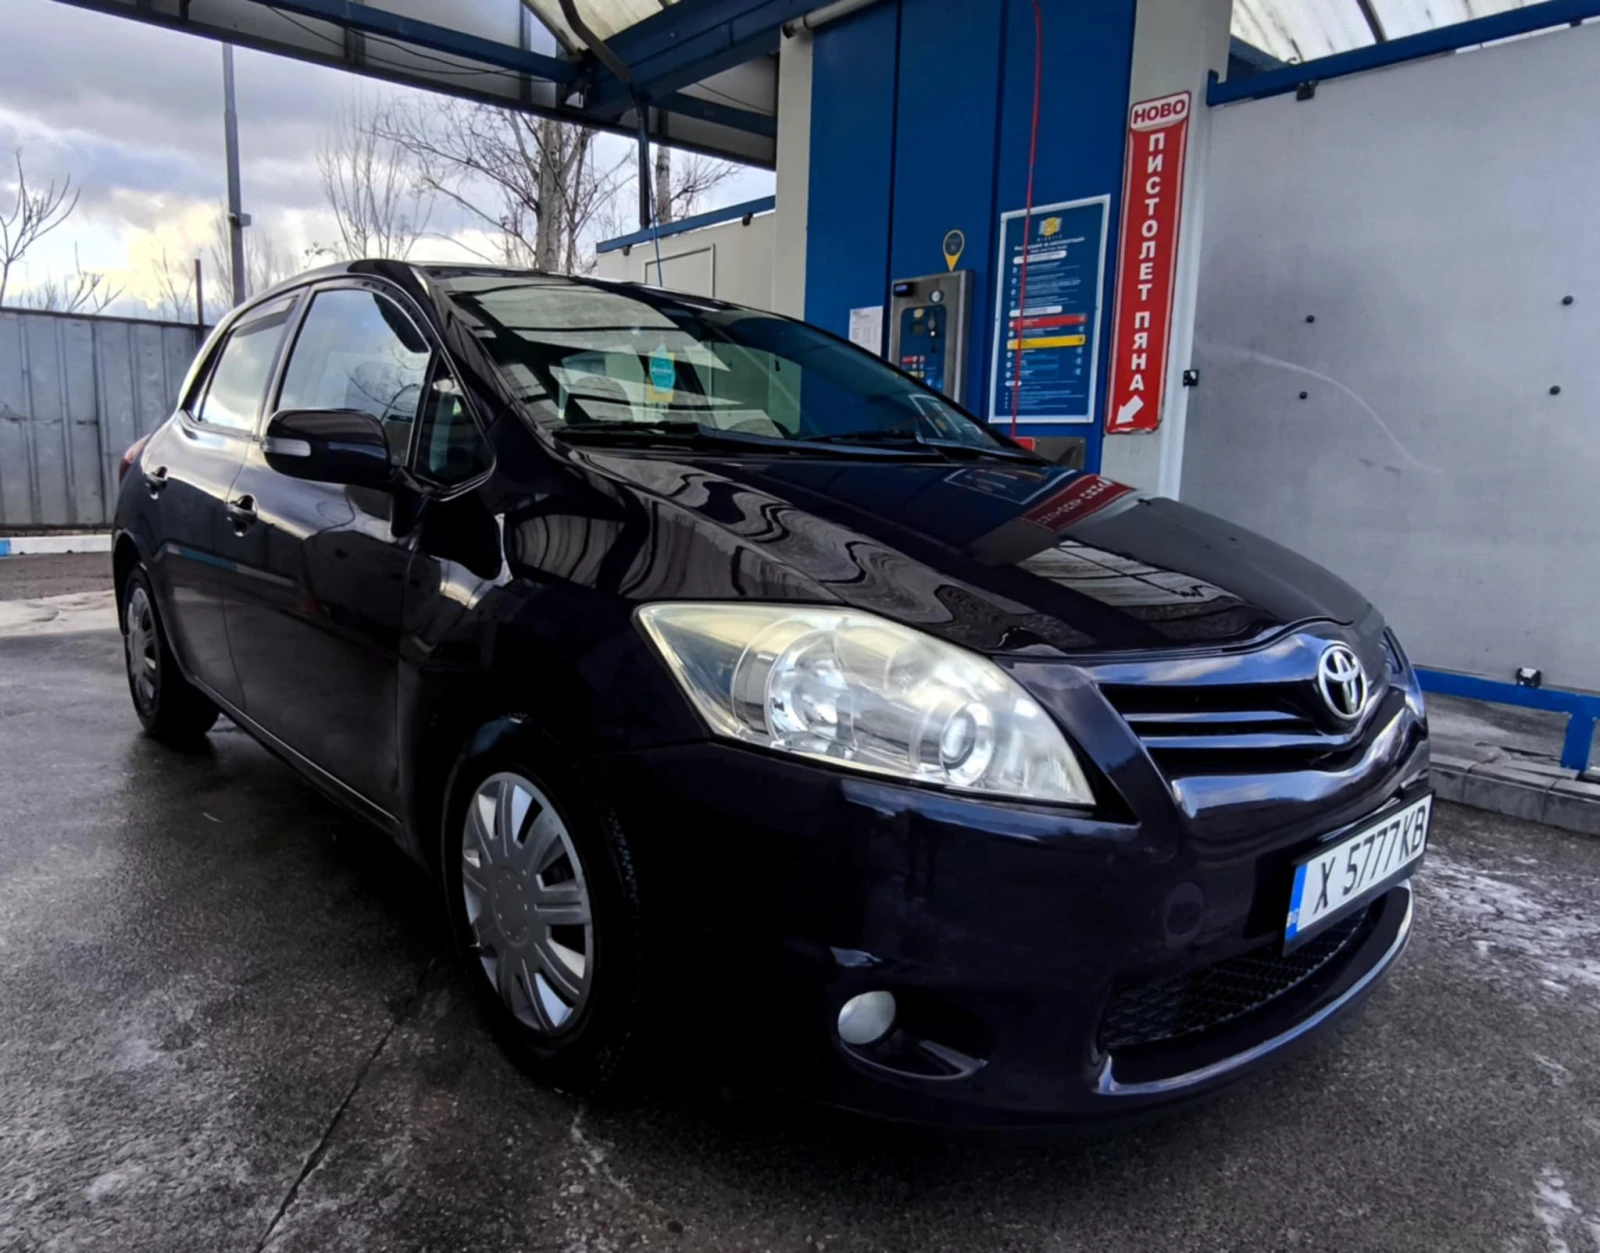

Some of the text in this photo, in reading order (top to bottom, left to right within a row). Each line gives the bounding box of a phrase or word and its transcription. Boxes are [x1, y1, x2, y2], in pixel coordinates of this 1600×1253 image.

[1132, 99, 1187, 124] НОВО
[1128, 131, 1166, 392] ПИСТОЛЕТ ПЯНА
[1312, 856, 1337, 916] X
